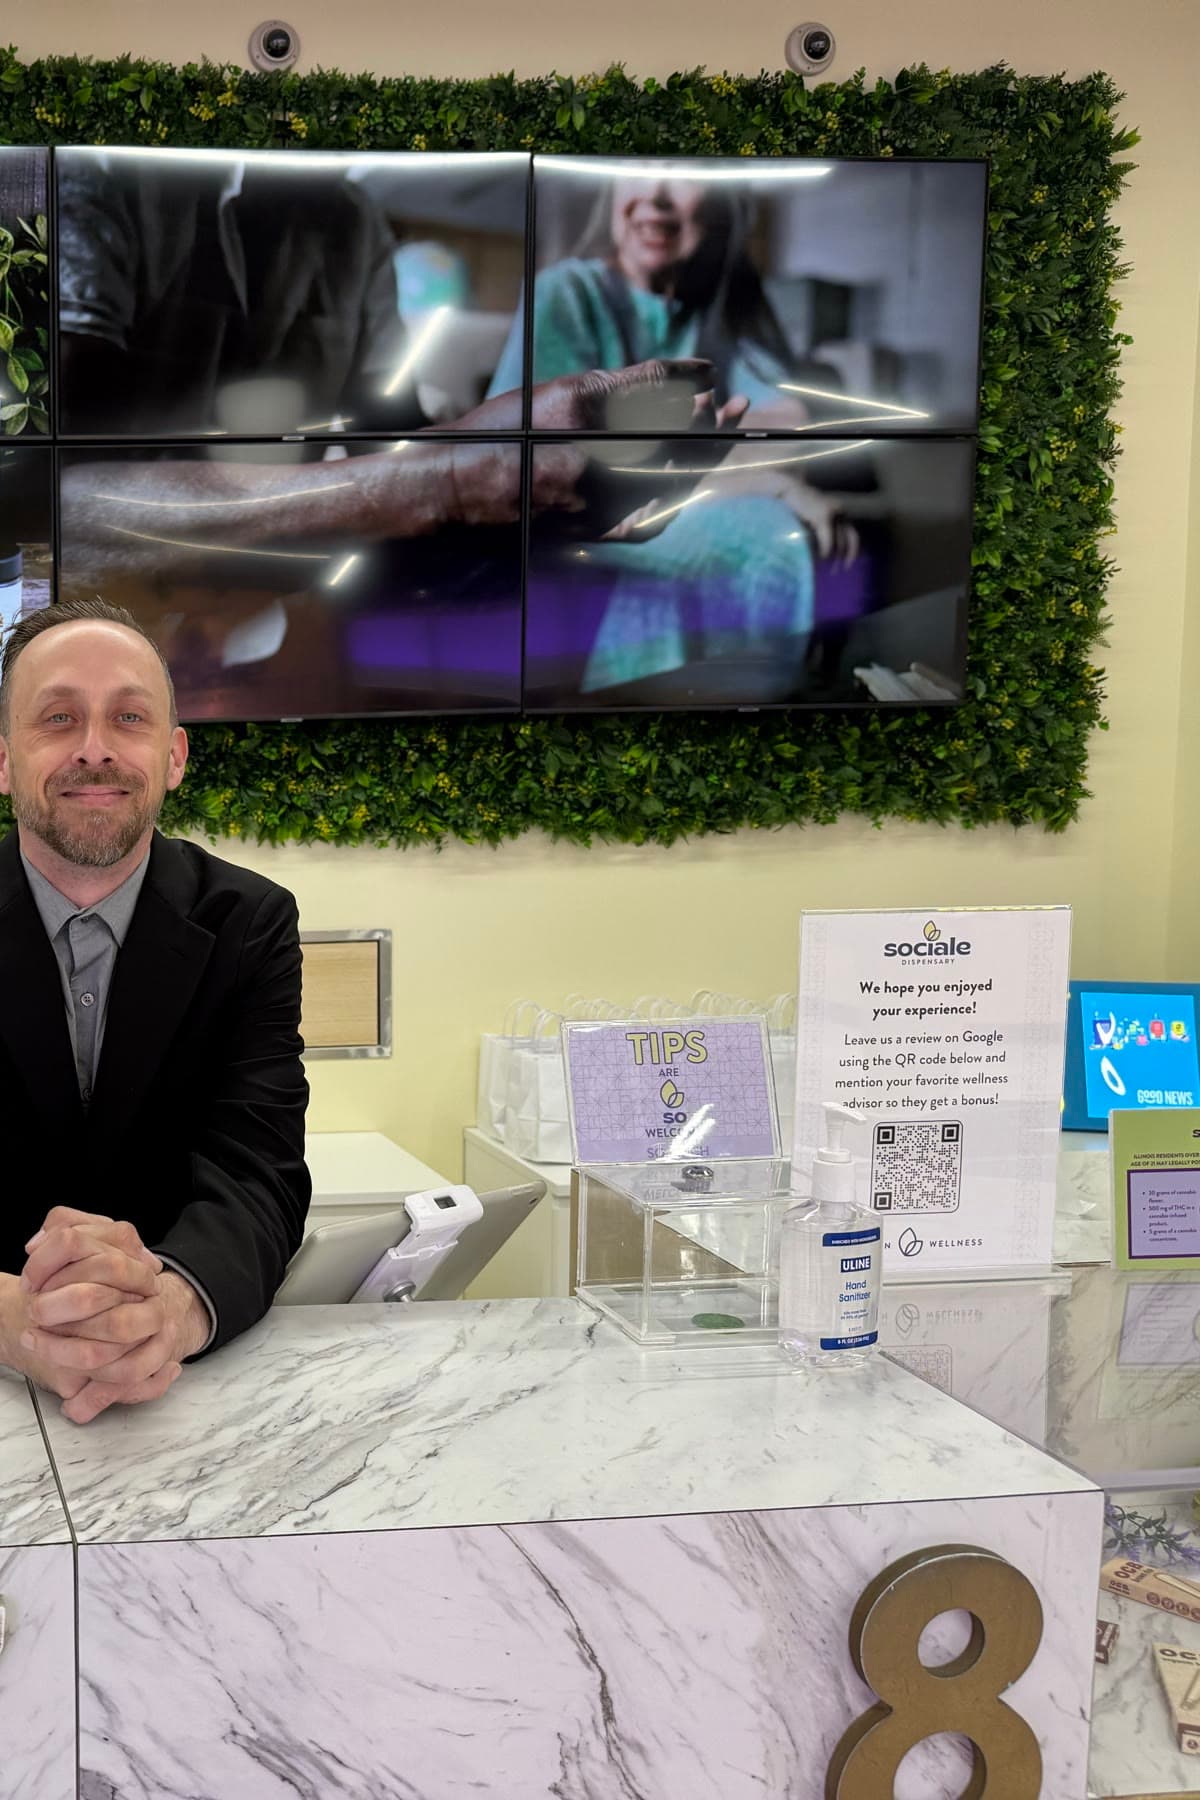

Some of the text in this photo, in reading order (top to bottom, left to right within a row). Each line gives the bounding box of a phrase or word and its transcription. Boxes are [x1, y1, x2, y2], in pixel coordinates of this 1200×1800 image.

[883, 937, 971, 957] sociale
[860, 978, 993, 997] We hope you enjoyed
[872, 1001, 977, 1021] your experience!
[844, 1030, 1003, 1046] Leave us a review on Google
[625, 1031, 708, 1065] TIPS
[839, 1051, 1006, 1070] using the QR code below and
[658, 1068, 679, 1077] ARE
[835, 1072, 1008, 1091] mention your favorite wellness
[842, 1093, 999, 1111] advisor so they get a bonus!
[1137, 1089, 1194, 1106] GOOD NEWS
[663, 1112, 687, 1123] SO
[929, 1238, 983, 1248] WELLNESS
[842, 1257, 870, 1271] ULINE
[845, 1280, 867, 1290] Hand
[839, 1291, 871, 1302] Sanitizer
[1114, 1561, 1143, 1579] OCB
[1160, 1649, 1200, 1661] OC
[825, 1543, 1043, 1800] 8
